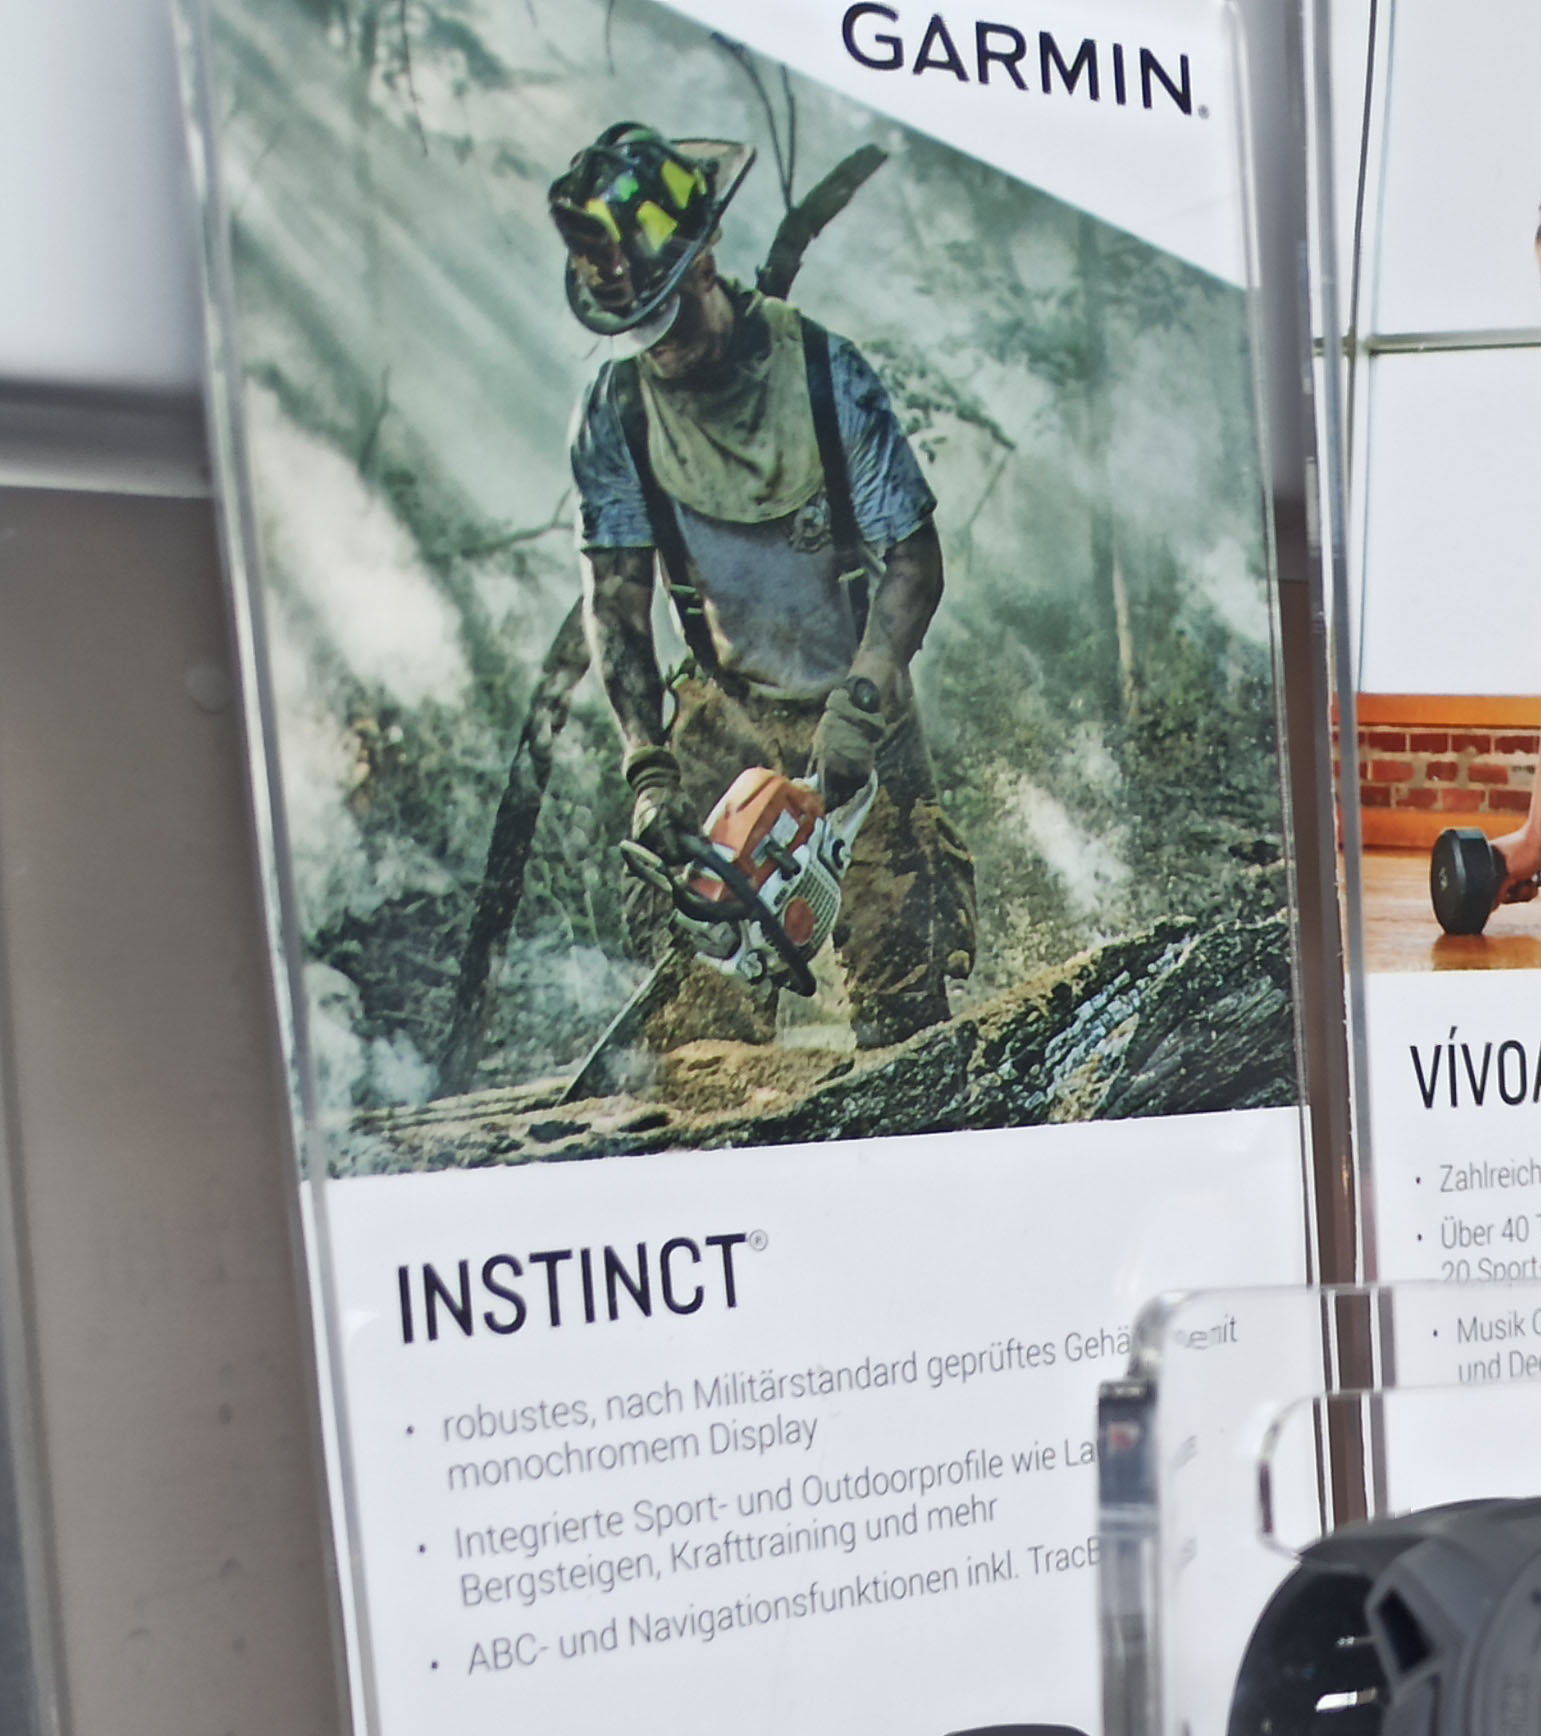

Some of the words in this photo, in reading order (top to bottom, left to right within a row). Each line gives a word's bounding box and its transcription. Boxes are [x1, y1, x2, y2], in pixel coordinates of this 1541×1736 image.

[1441, 1215, 1494, 1250] Über
[1501, 1215, 1529, 1243] 40
[1441, 1259, 1470, 1283] 20
[1457, 1311, 1526, 1344] Musik
[442, 1400, 597, 1442] robustes,
[606, 1381, 684, 1420] nach
[693, 1349, 918, 1411] Militärstandard
[927, 1336, 1057, 1389] geprüftes
[1458, 1352, 1501, 1385] und
[448, 1431, 700, 1490] monochromem
[709, 1413, 818, 1457] Display
[455, 1511, 625, 1559] Integrierte
[633, 1492, 729, 1536] Sport-
[737, 1478, 793, 1518] und
[801, 1446, 1004, 1507] Outdoorprofile
[1011, 1436, 1056, 1474] wie
[460, 1553, 661, 1608] Bergsteigen,
[670, 1519, 857, 1574] Krafttraining
[865, 1505, 918, 1545] und
[926, 1493, 998, 1533] mehr
[467, 1632, 549, 1676] ABC-
[559, 1617, 620, 1660] und
[628, 1561, 960, 1644] Navigationsfunktionen
[966, 1549, 1020, 1588] inkl.
